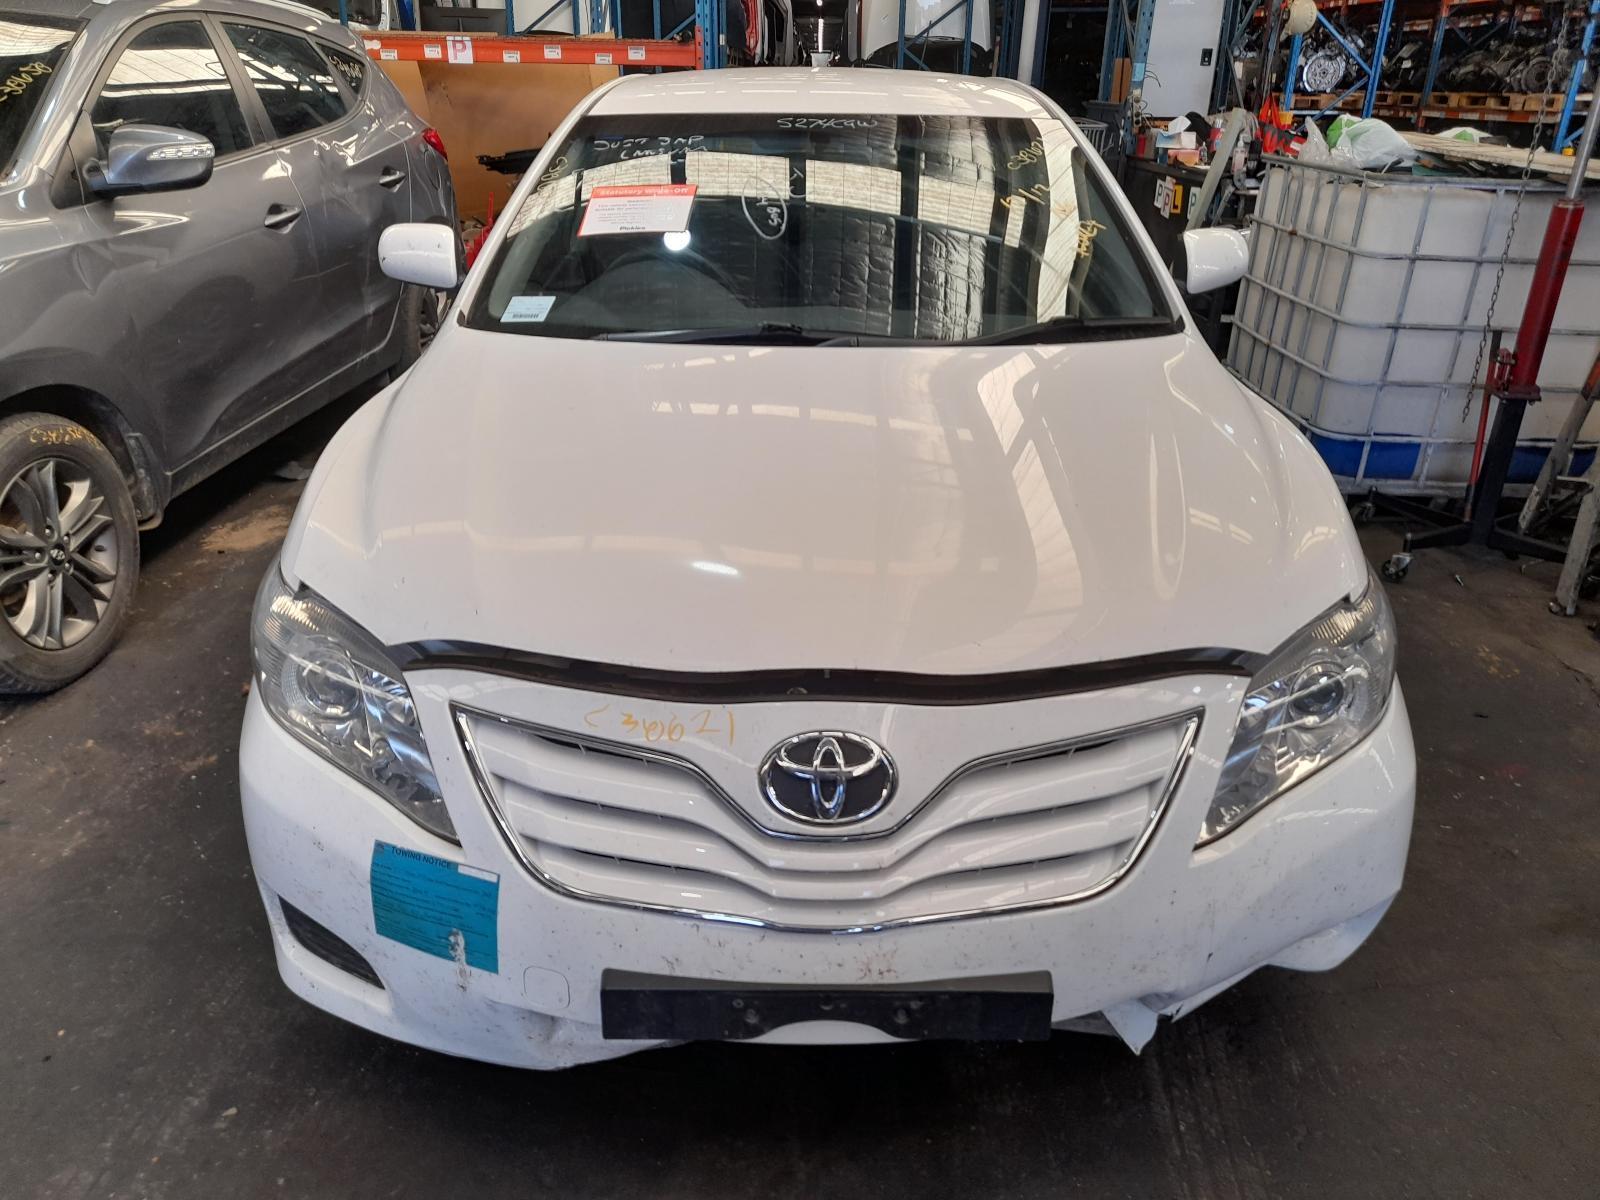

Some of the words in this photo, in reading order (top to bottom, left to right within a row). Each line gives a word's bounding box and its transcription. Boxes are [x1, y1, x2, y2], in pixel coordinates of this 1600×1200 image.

[451, 40, 467, 60] P
[391, 846, 421, 862] TOWING
[422, 853, 450, 870] NOTICE
